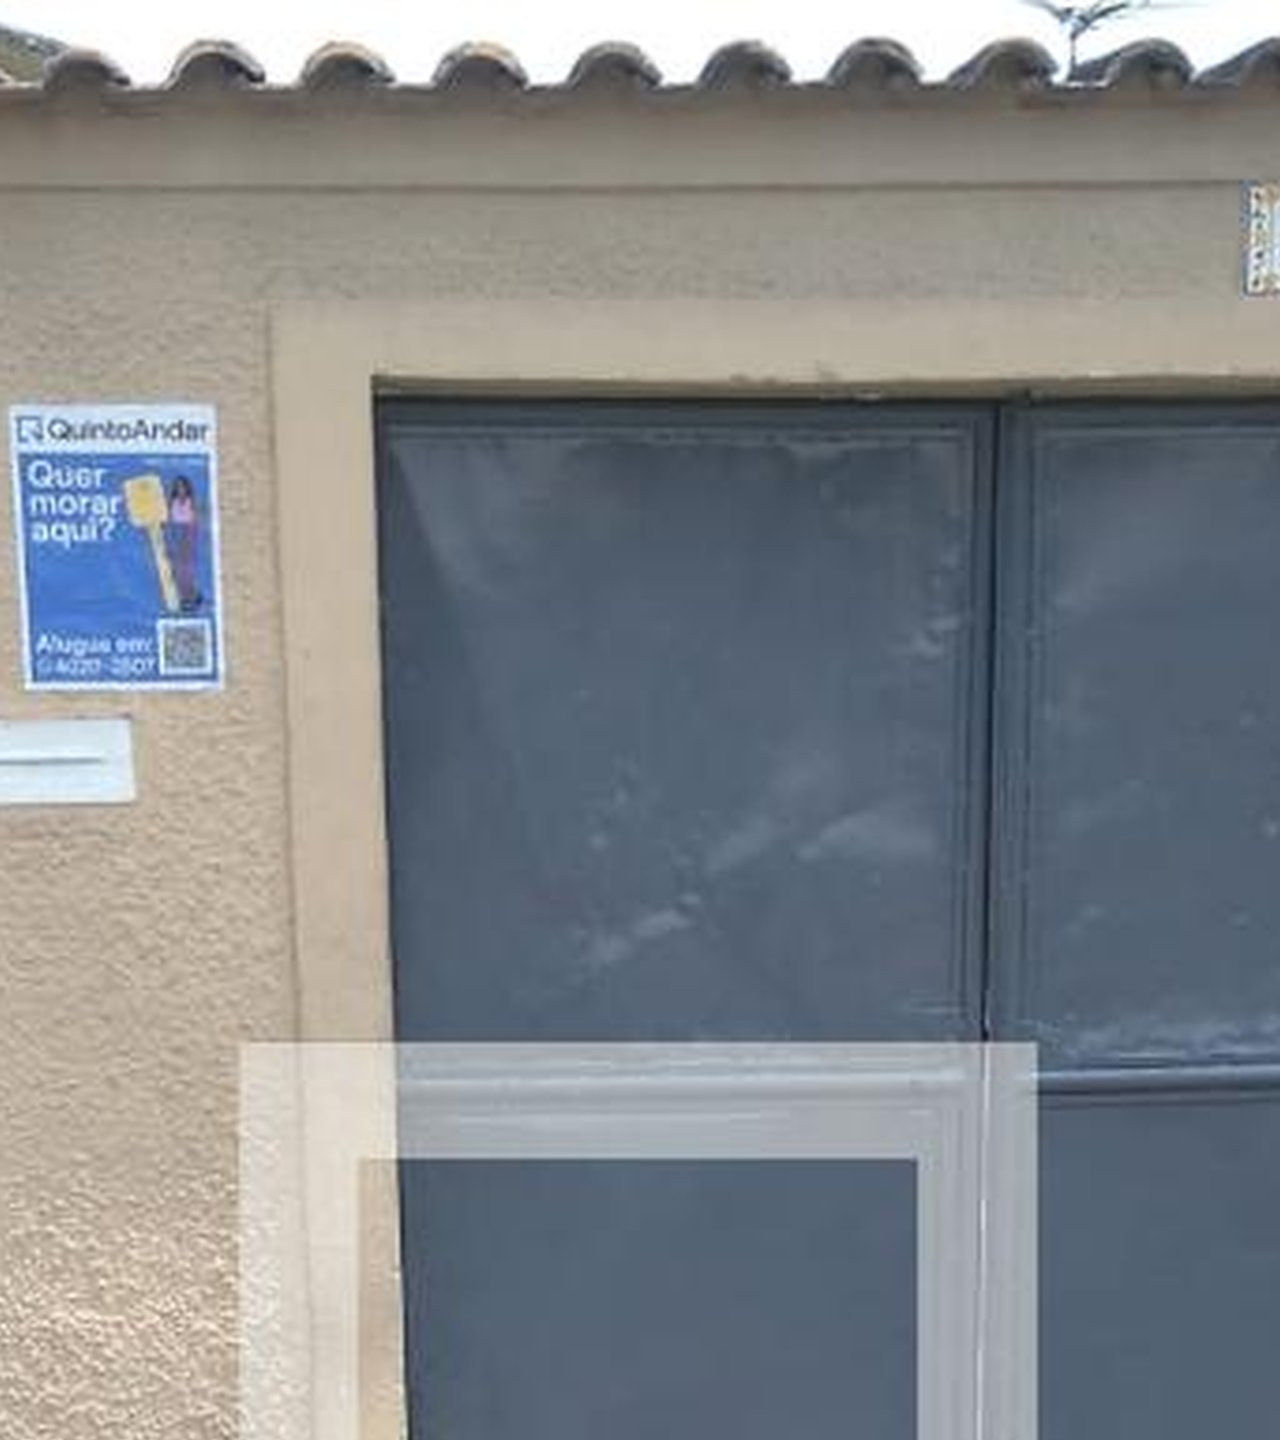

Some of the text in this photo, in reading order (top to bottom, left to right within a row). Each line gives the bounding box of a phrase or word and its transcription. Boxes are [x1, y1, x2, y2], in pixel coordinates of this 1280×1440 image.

[48, 419, 208, 442] QuintoAndar
[28, 460, 107, 488] Quer
[30, 494, 121, 515] morar
[32, 517, 115, 549] aqui?
